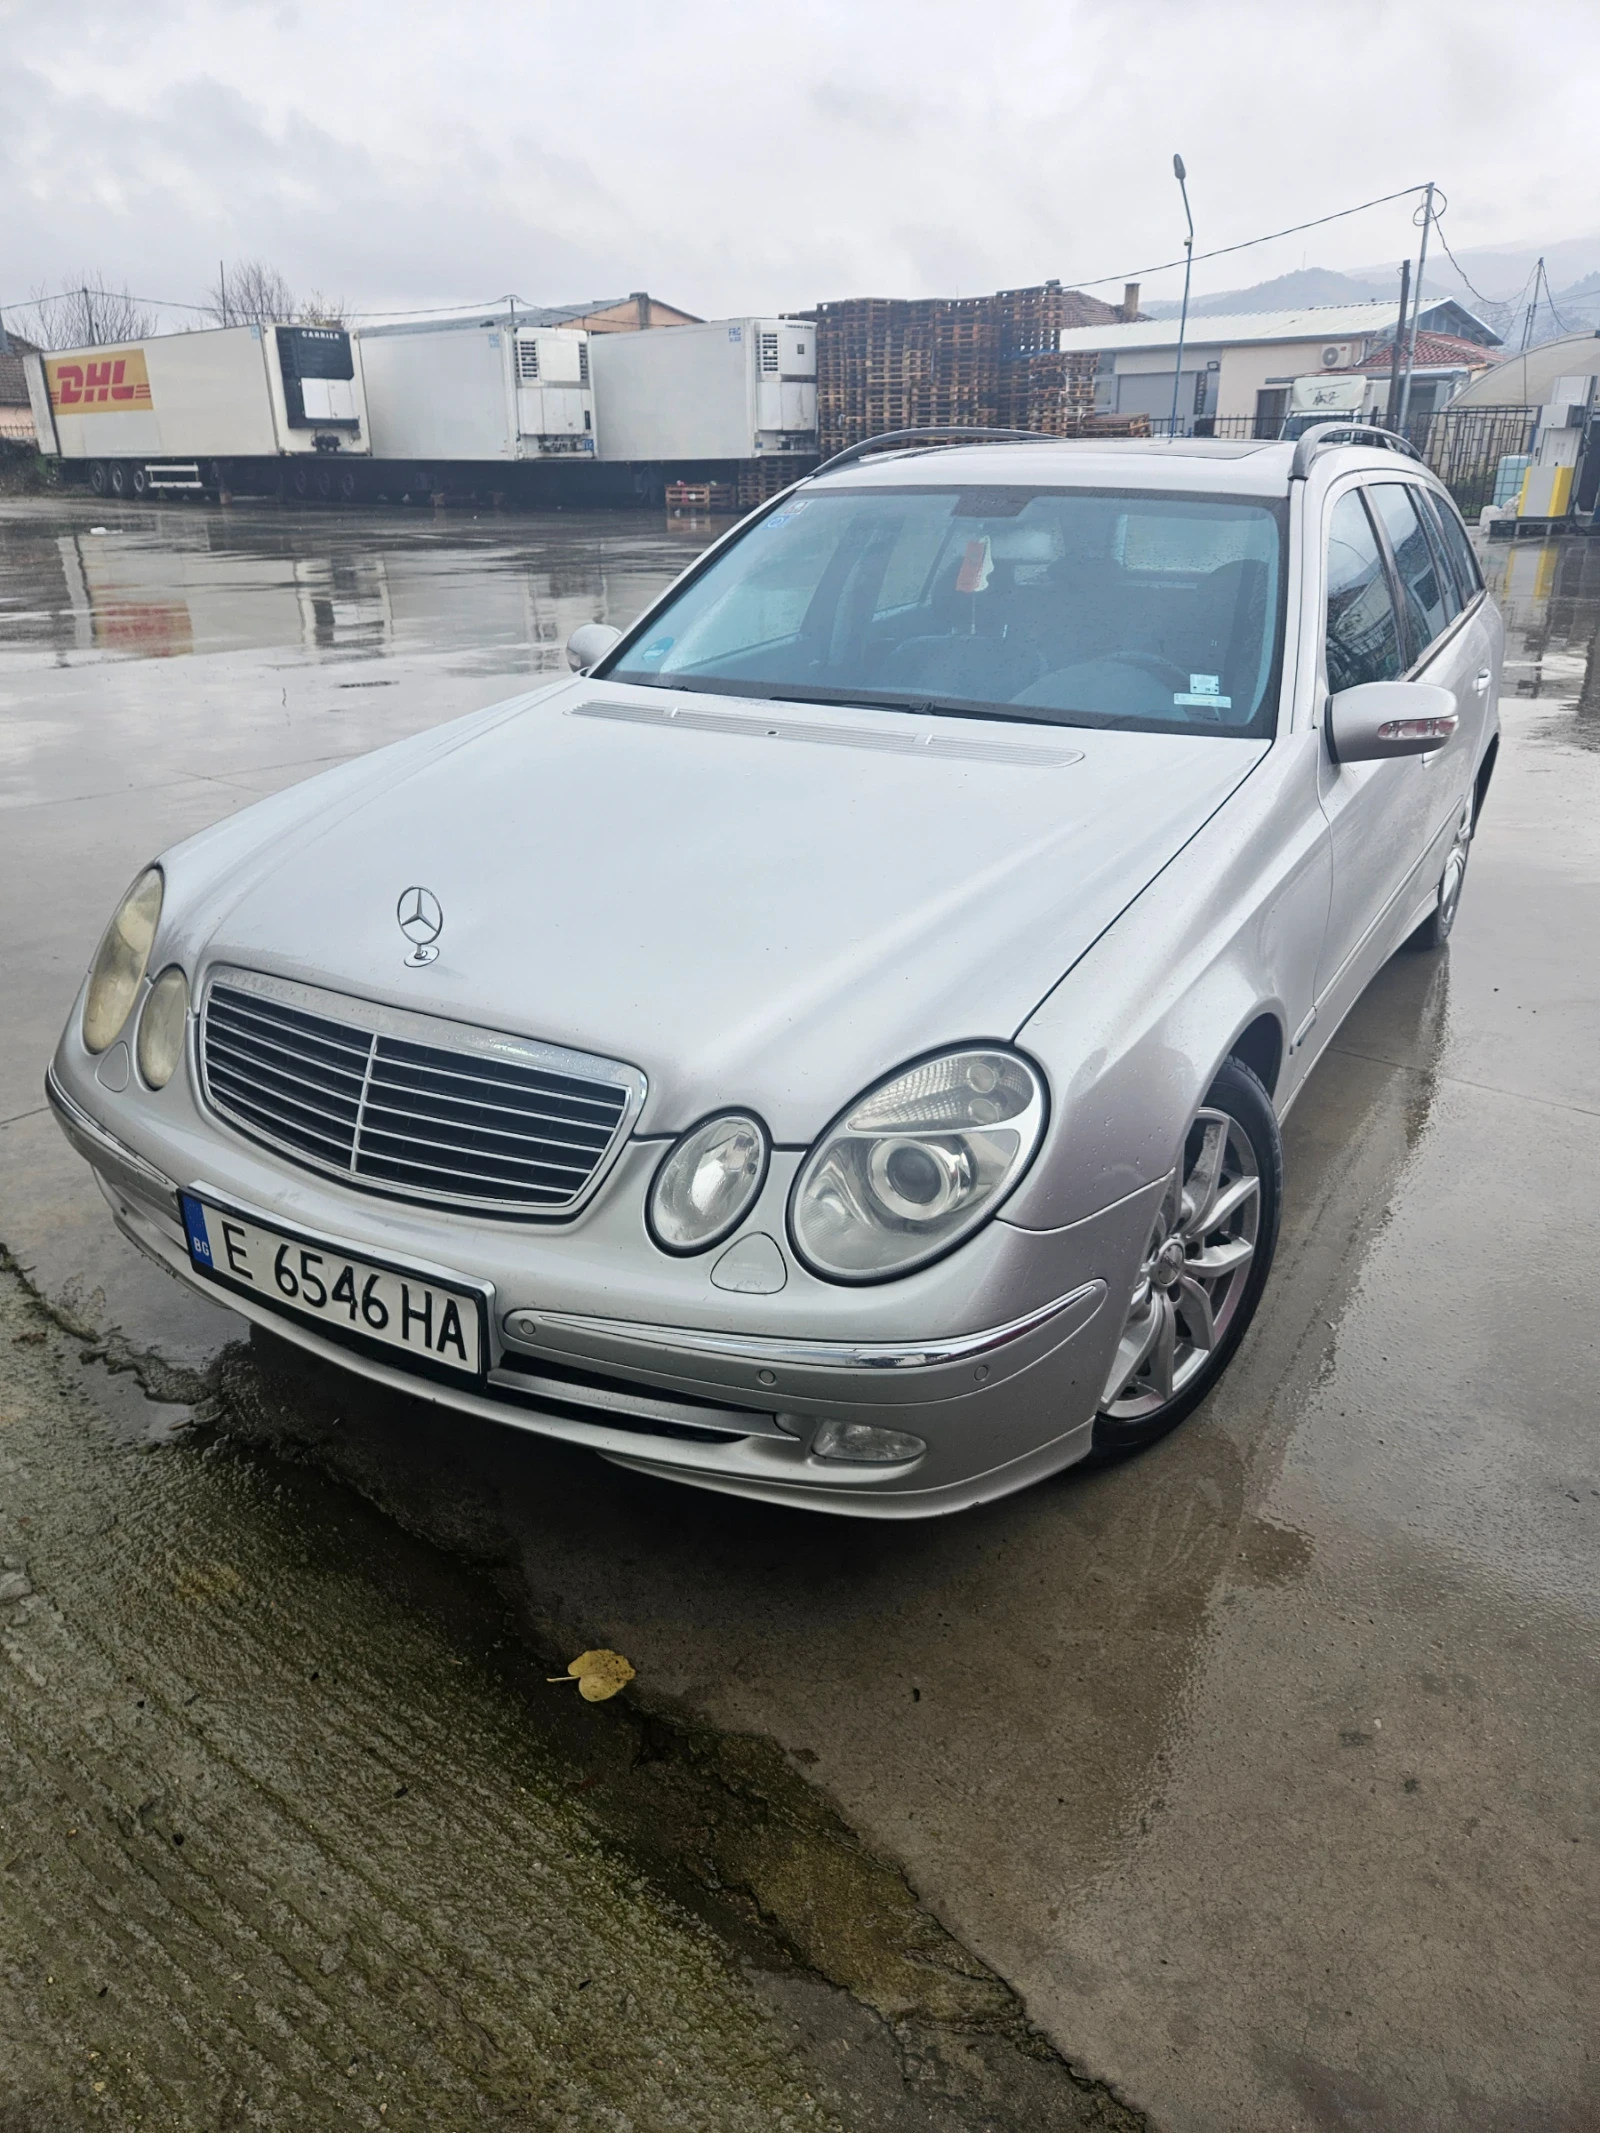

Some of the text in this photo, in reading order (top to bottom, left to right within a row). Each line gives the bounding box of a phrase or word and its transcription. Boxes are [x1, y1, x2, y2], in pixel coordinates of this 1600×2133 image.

[301, 330, 340, 340] CARRIER
[57, 360, 134, 404] DHL
[193, 1236, 210, 1257] BG
[221, 1220, 468, 1361] E 6546 HA
